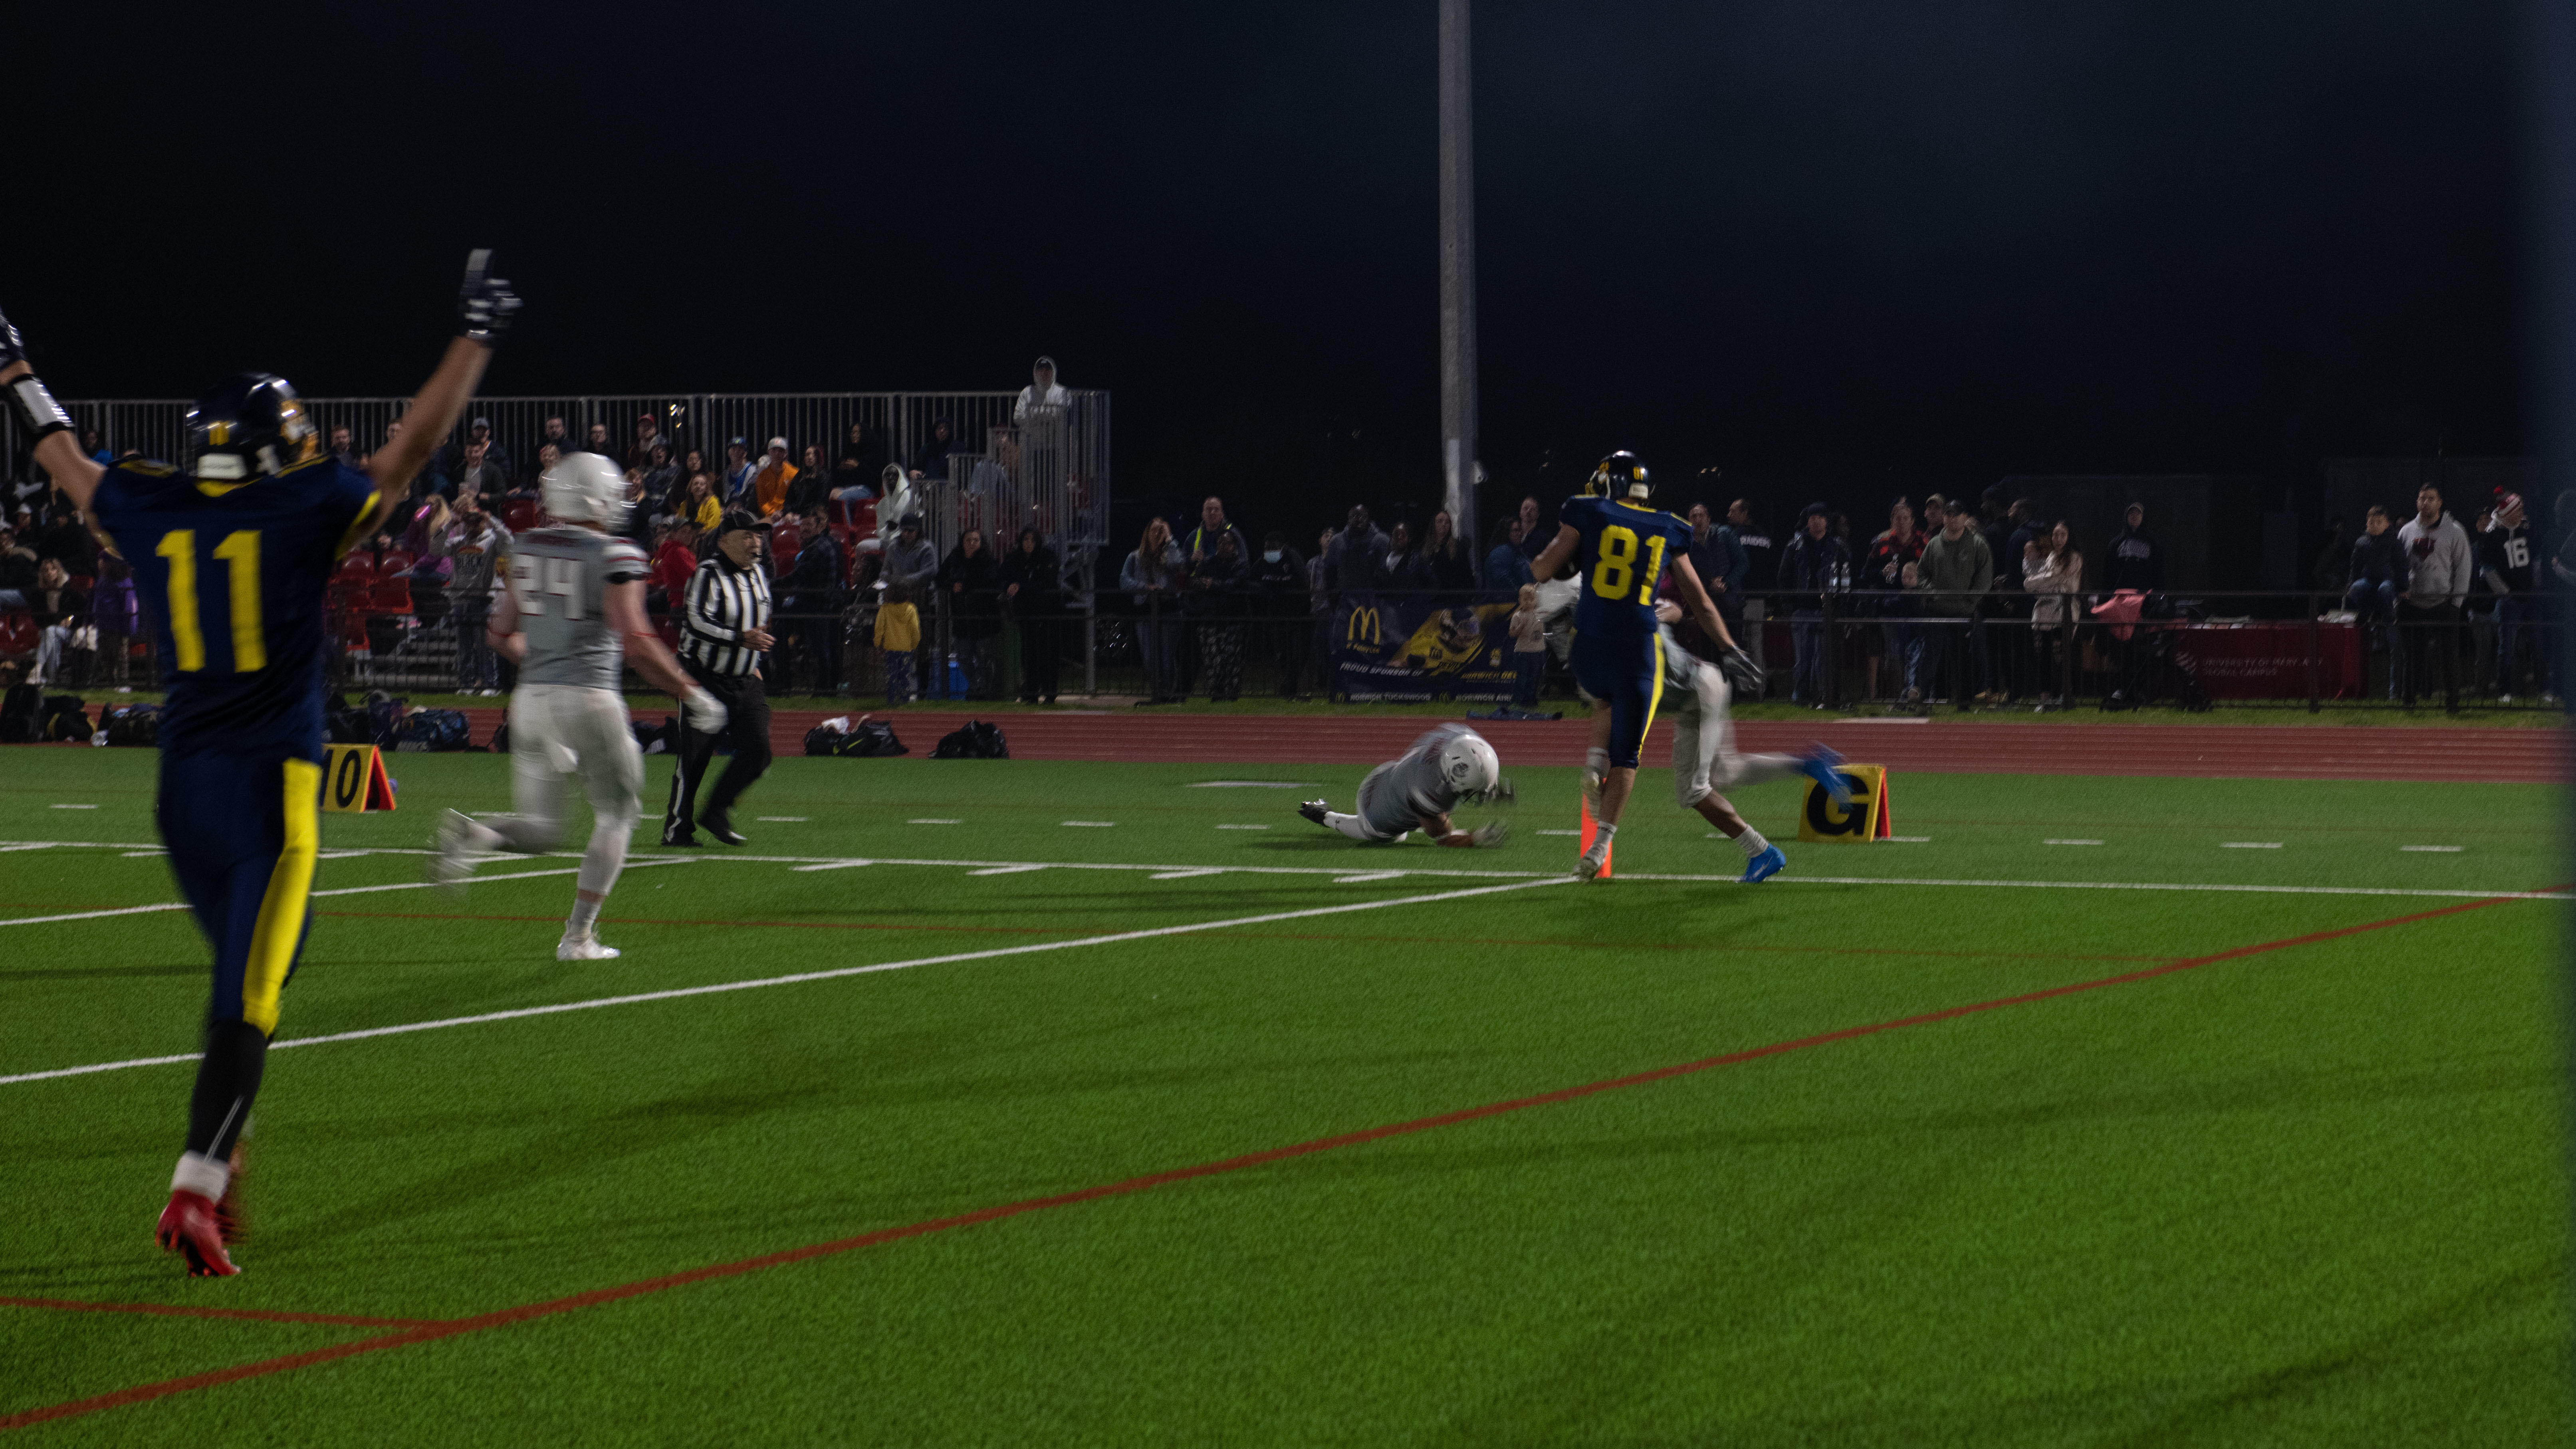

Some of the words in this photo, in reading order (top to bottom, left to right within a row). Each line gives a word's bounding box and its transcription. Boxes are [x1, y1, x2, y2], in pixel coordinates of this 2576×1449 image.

[1739, 535, 1771, 549] RAIDERS
[2503, 536, 2530, 569] 16
[1591, 524, 1667, 606] 81
[511, 553, 586, 622] 24
[155, 529, 269, 673] 11
[1339, 661, 1370, 673] PROUD
[1369, 666, 1412, 676] SPONSOR
[2239, 667, 2278, 676] CAMPUS
[2272, 657, 2323, 667] MARYA
[1350, 692, 1383, 701] NORWICH
[1383, 692, 1433, 702] TUCKSWOOD
[1455, 692, 1495, 702] NORWICH
[318, 749, 361, 808] 10
[1807, 773, 1869, 836] G
